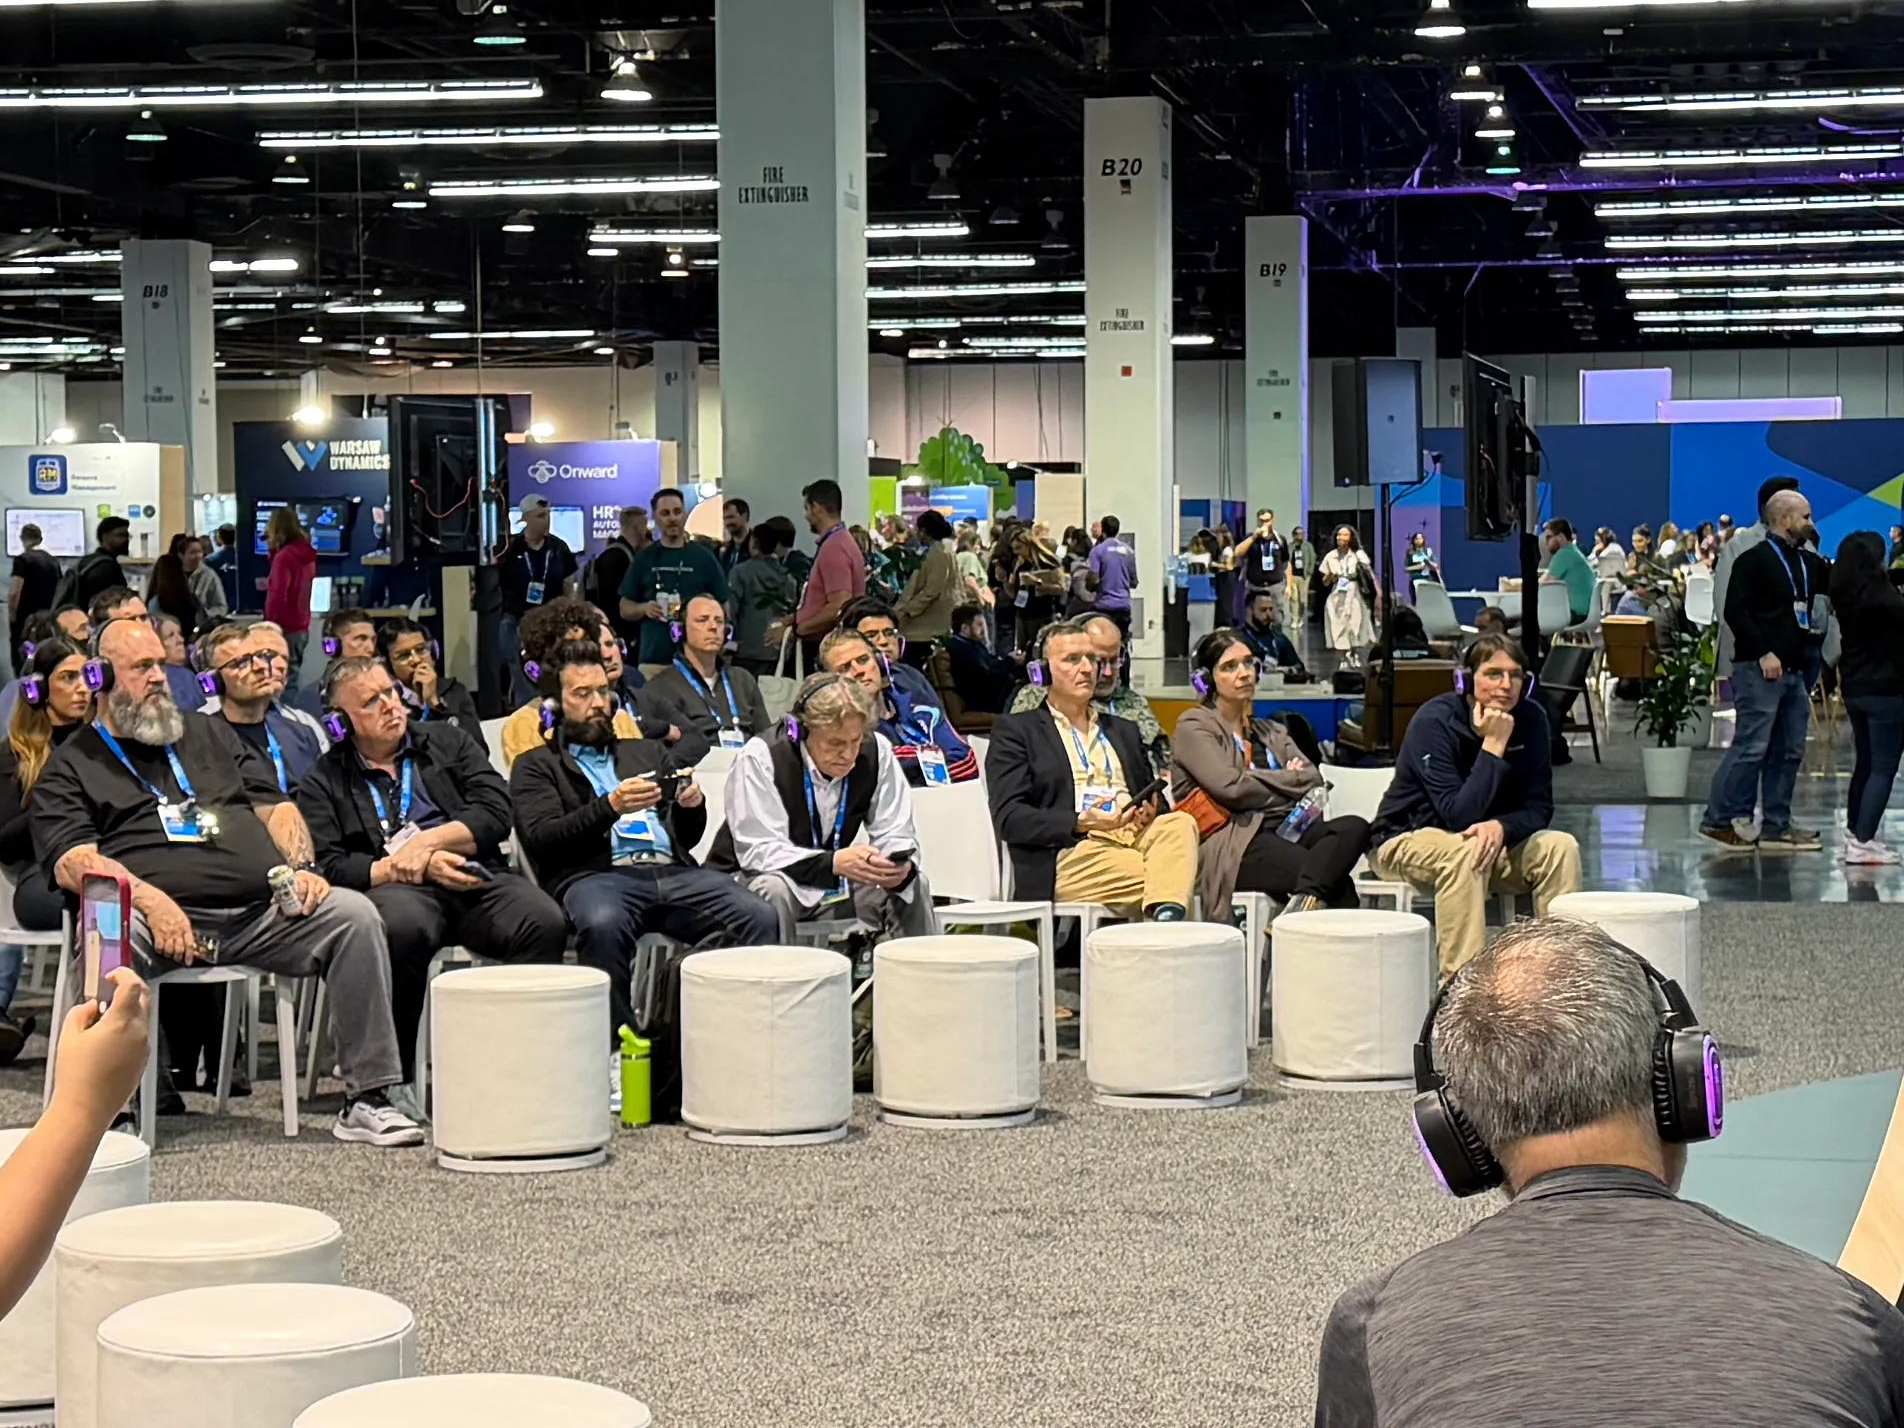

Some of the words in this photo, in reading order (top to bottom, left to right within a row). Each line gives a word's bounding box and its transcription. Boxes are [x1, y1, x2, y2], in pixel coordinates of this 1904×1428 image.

[763, 166, 783, 184] FIRE
[1101, 158, 1143, 176] B20
[738, 185, 809, 204] EXTINGUISHER
[1260, 263, 1287, 277] B19
[329, 440, 381, 455] WARSAW
[329, 454, 391, 471] DYNAMICS
[559, 463, 618, 479] Onward
